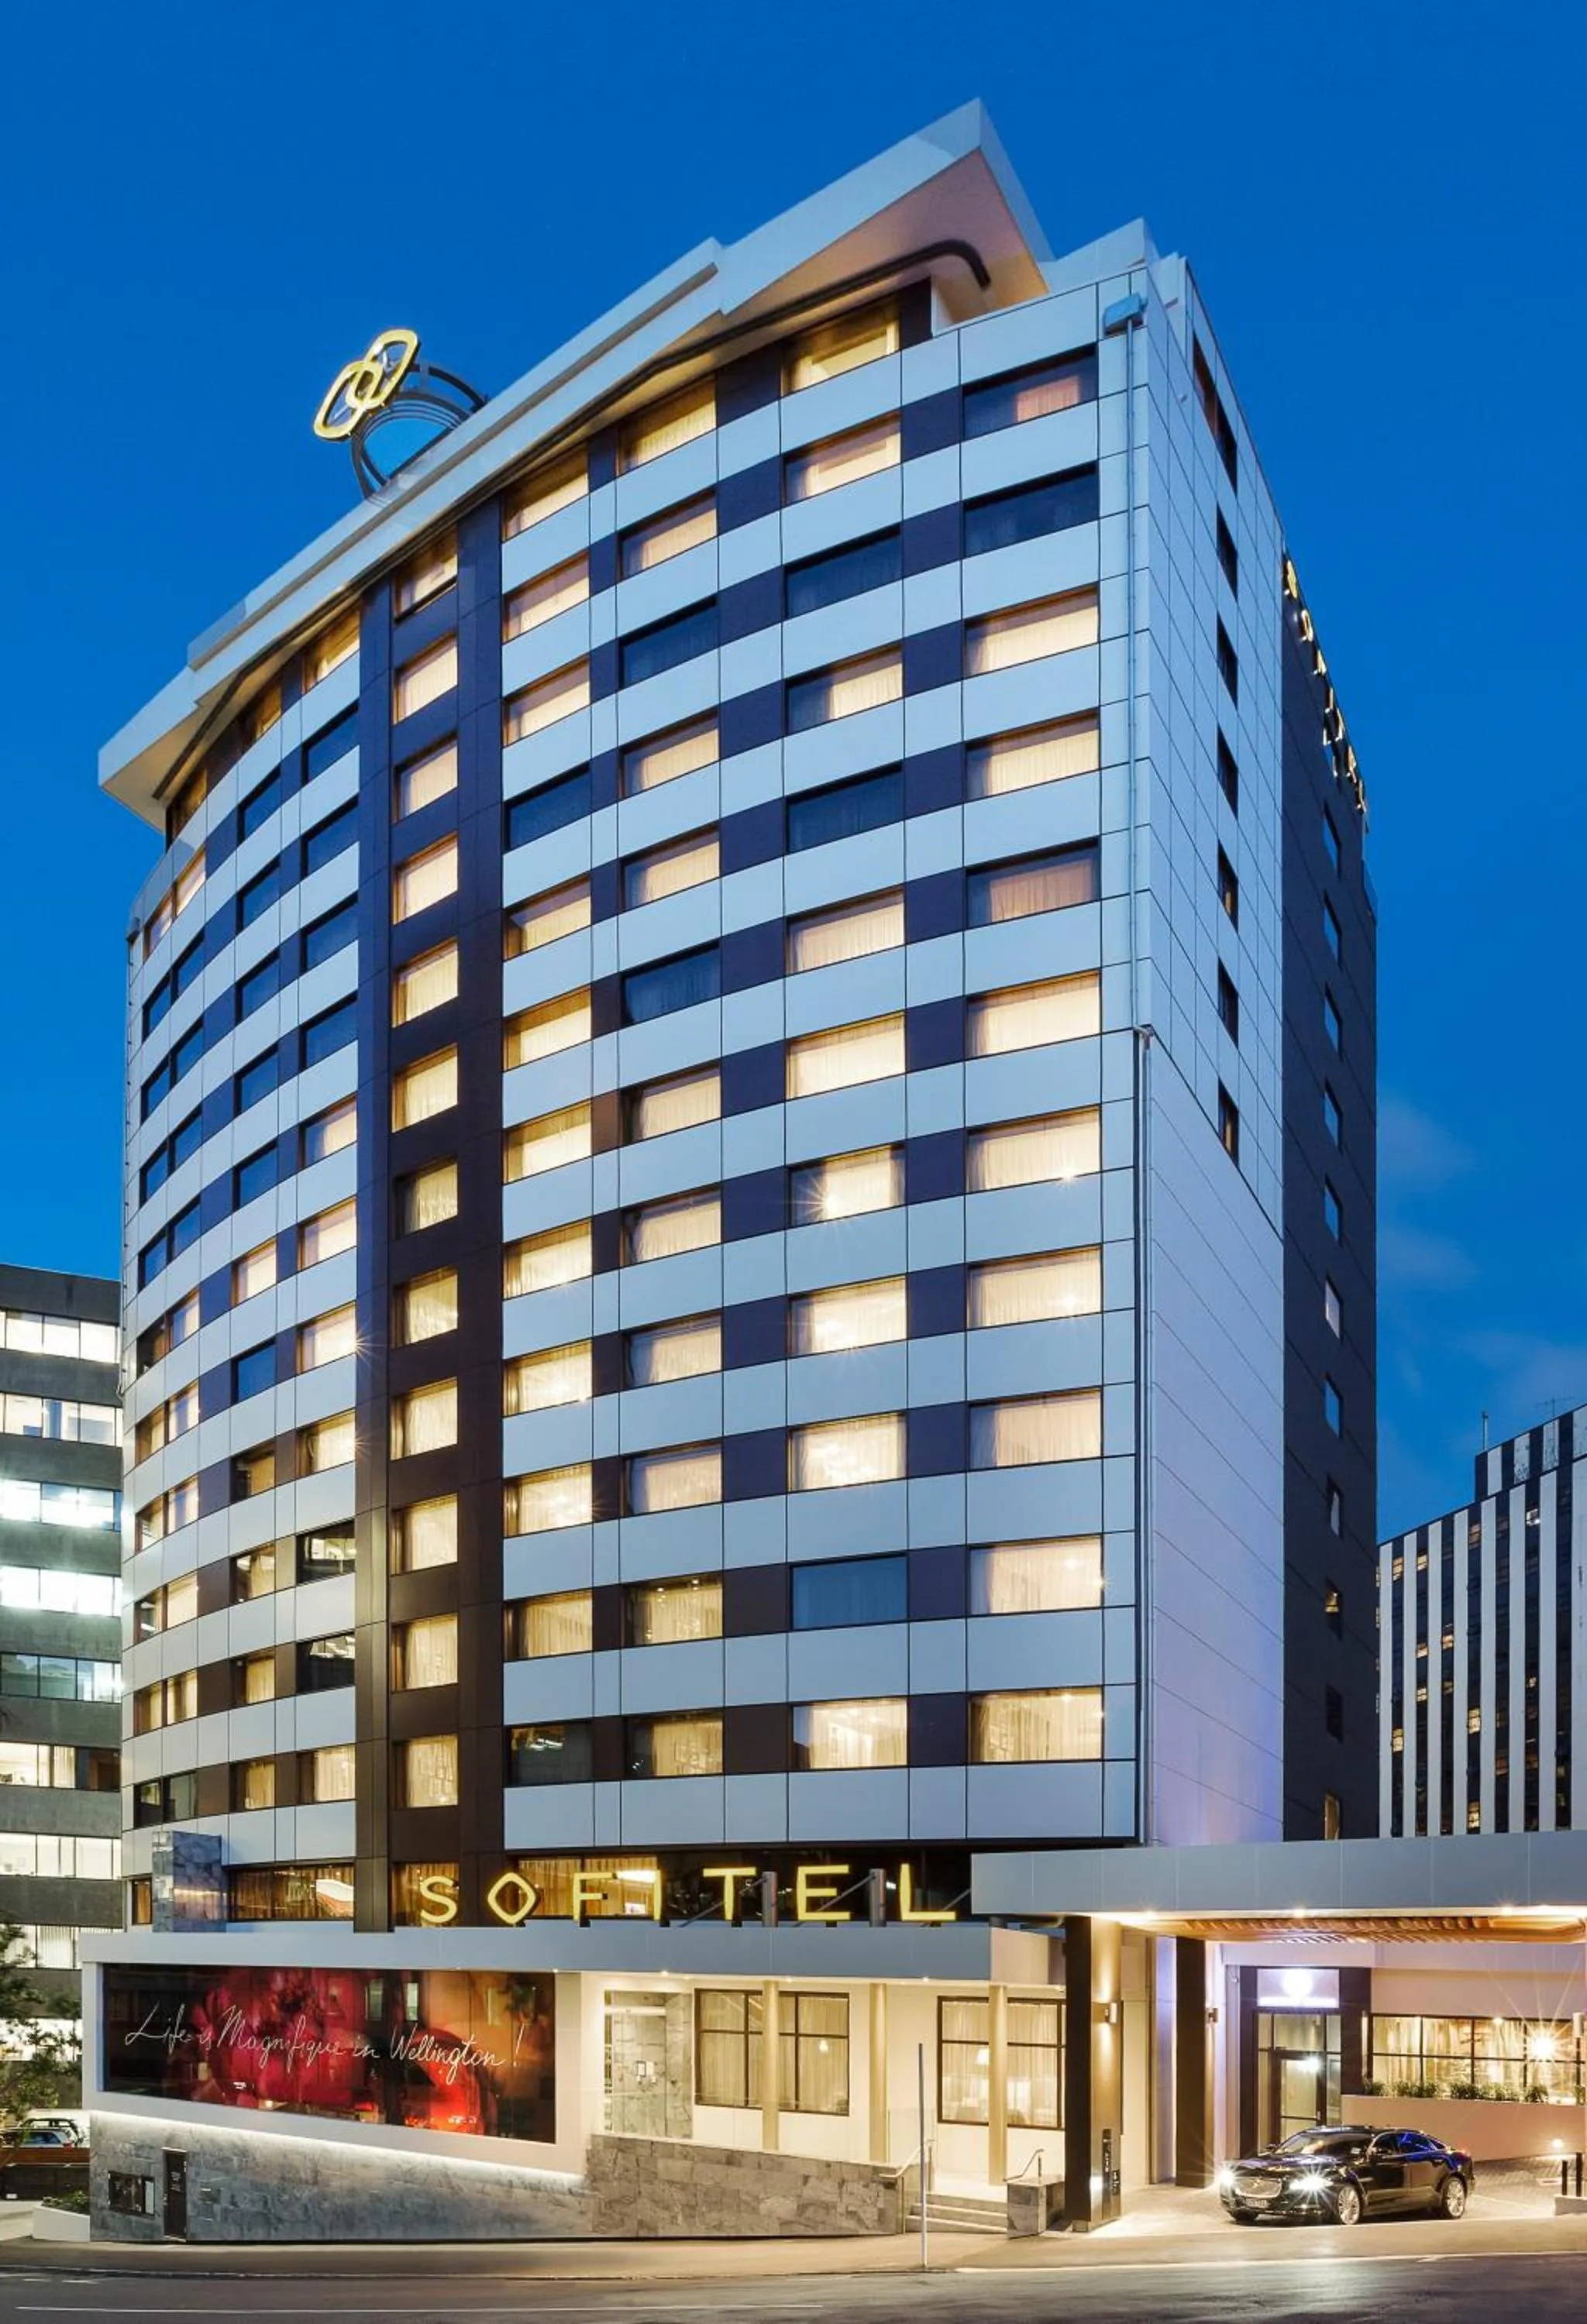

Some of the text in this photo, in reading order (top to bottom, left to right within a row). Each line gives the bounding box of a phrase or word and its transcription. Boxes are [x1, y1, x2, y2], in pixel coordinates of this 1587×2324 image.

[419, 1863, 956, 1924] SOFITEL
[125, 2000, 193, 2055] Life
[216, 2004, 346, 2074] Magnifique
[353, 2034, 380, 2058] in
